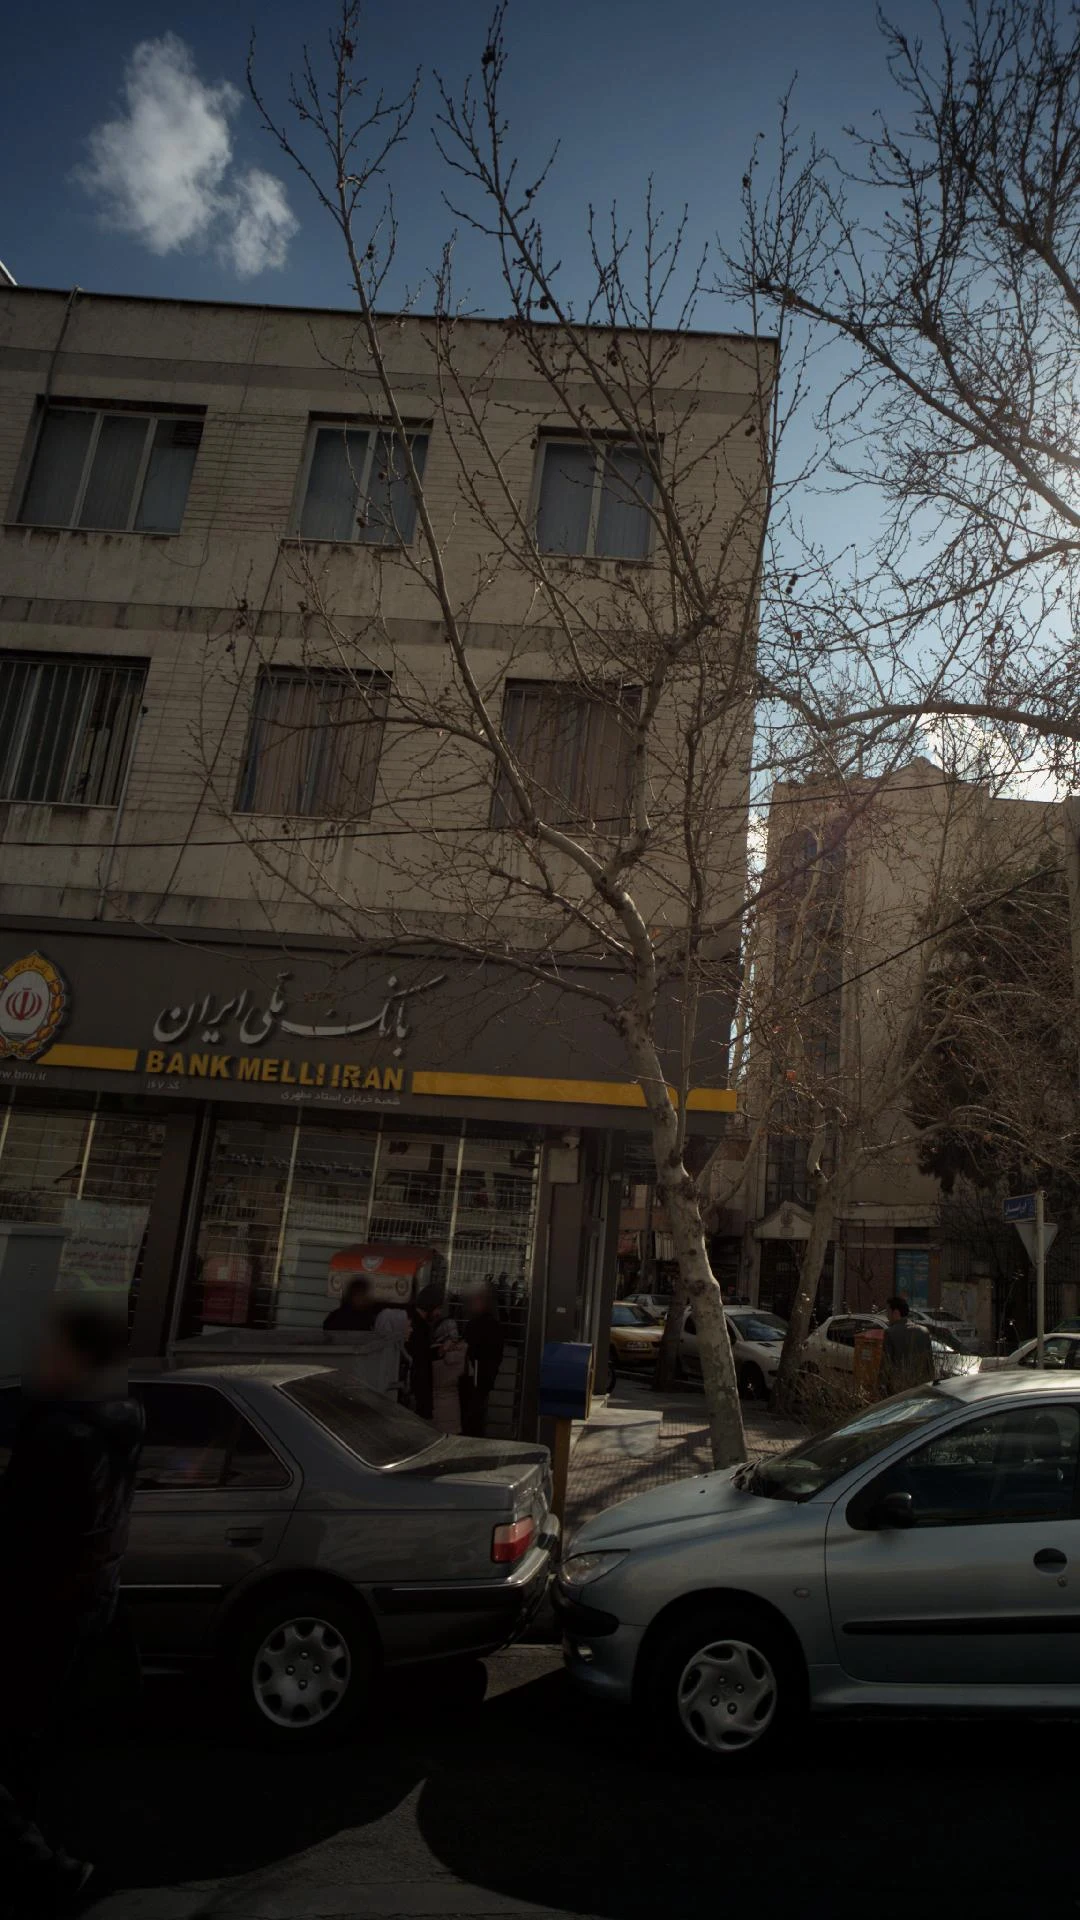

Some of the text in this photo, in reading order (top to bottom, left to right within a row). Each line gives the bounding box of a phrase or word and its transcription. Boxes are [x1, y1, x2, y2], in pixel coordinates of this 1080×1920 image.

[152, 988, 249, 1044] ایران
[280, 974, 446, 1058] بانک
[145, 1048, 405, 1092] BANK MELLI IRAN
[314, 1090, 342, 1102] استاد
[343, 1093, 373, 1105] خیابان
